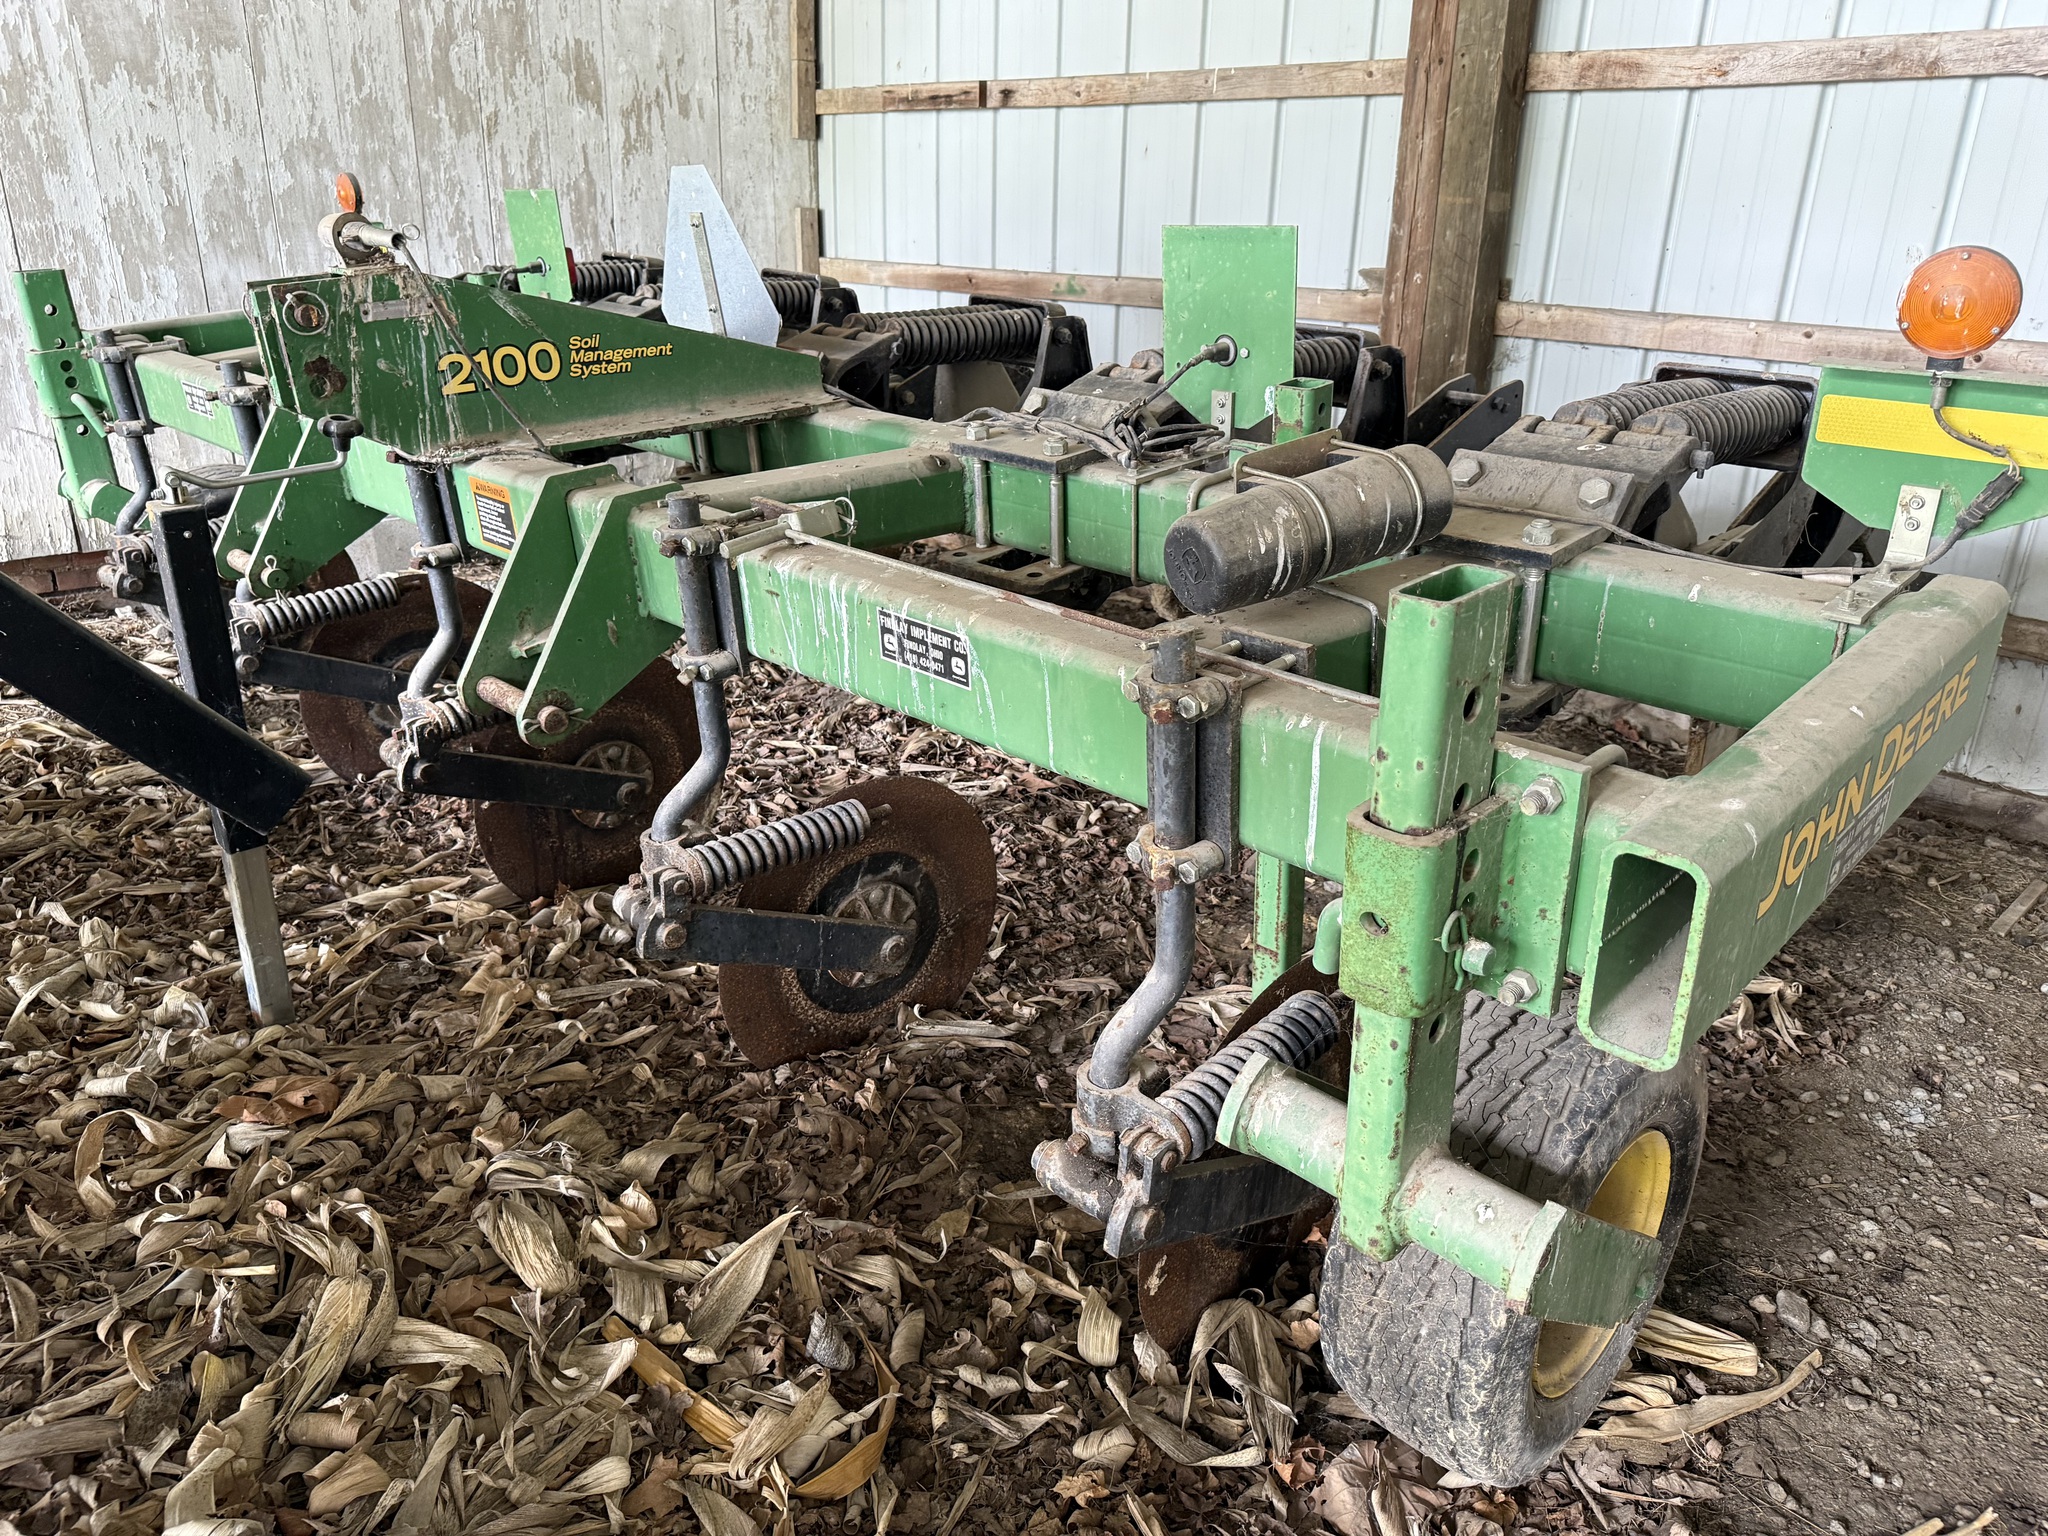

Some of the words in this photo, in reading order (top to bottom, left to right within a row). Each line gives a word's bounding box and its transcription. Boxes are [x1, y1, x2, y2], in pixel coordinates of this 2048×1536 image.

[568, 333, 600, 350] Soil
[569, 342, 673, 365] Management
[438, 340, 561, 395] 2100
[569, 359, 632, 380] System
[480, 483, 506, 499] WARNING
[879, 615, 908, 636] FINDLAY
[910, 625, 952, 650] IMPLEMENT
[1756, 761, 1871, 920] JOHN
[1869, 654, 1978, 798] DEERE
